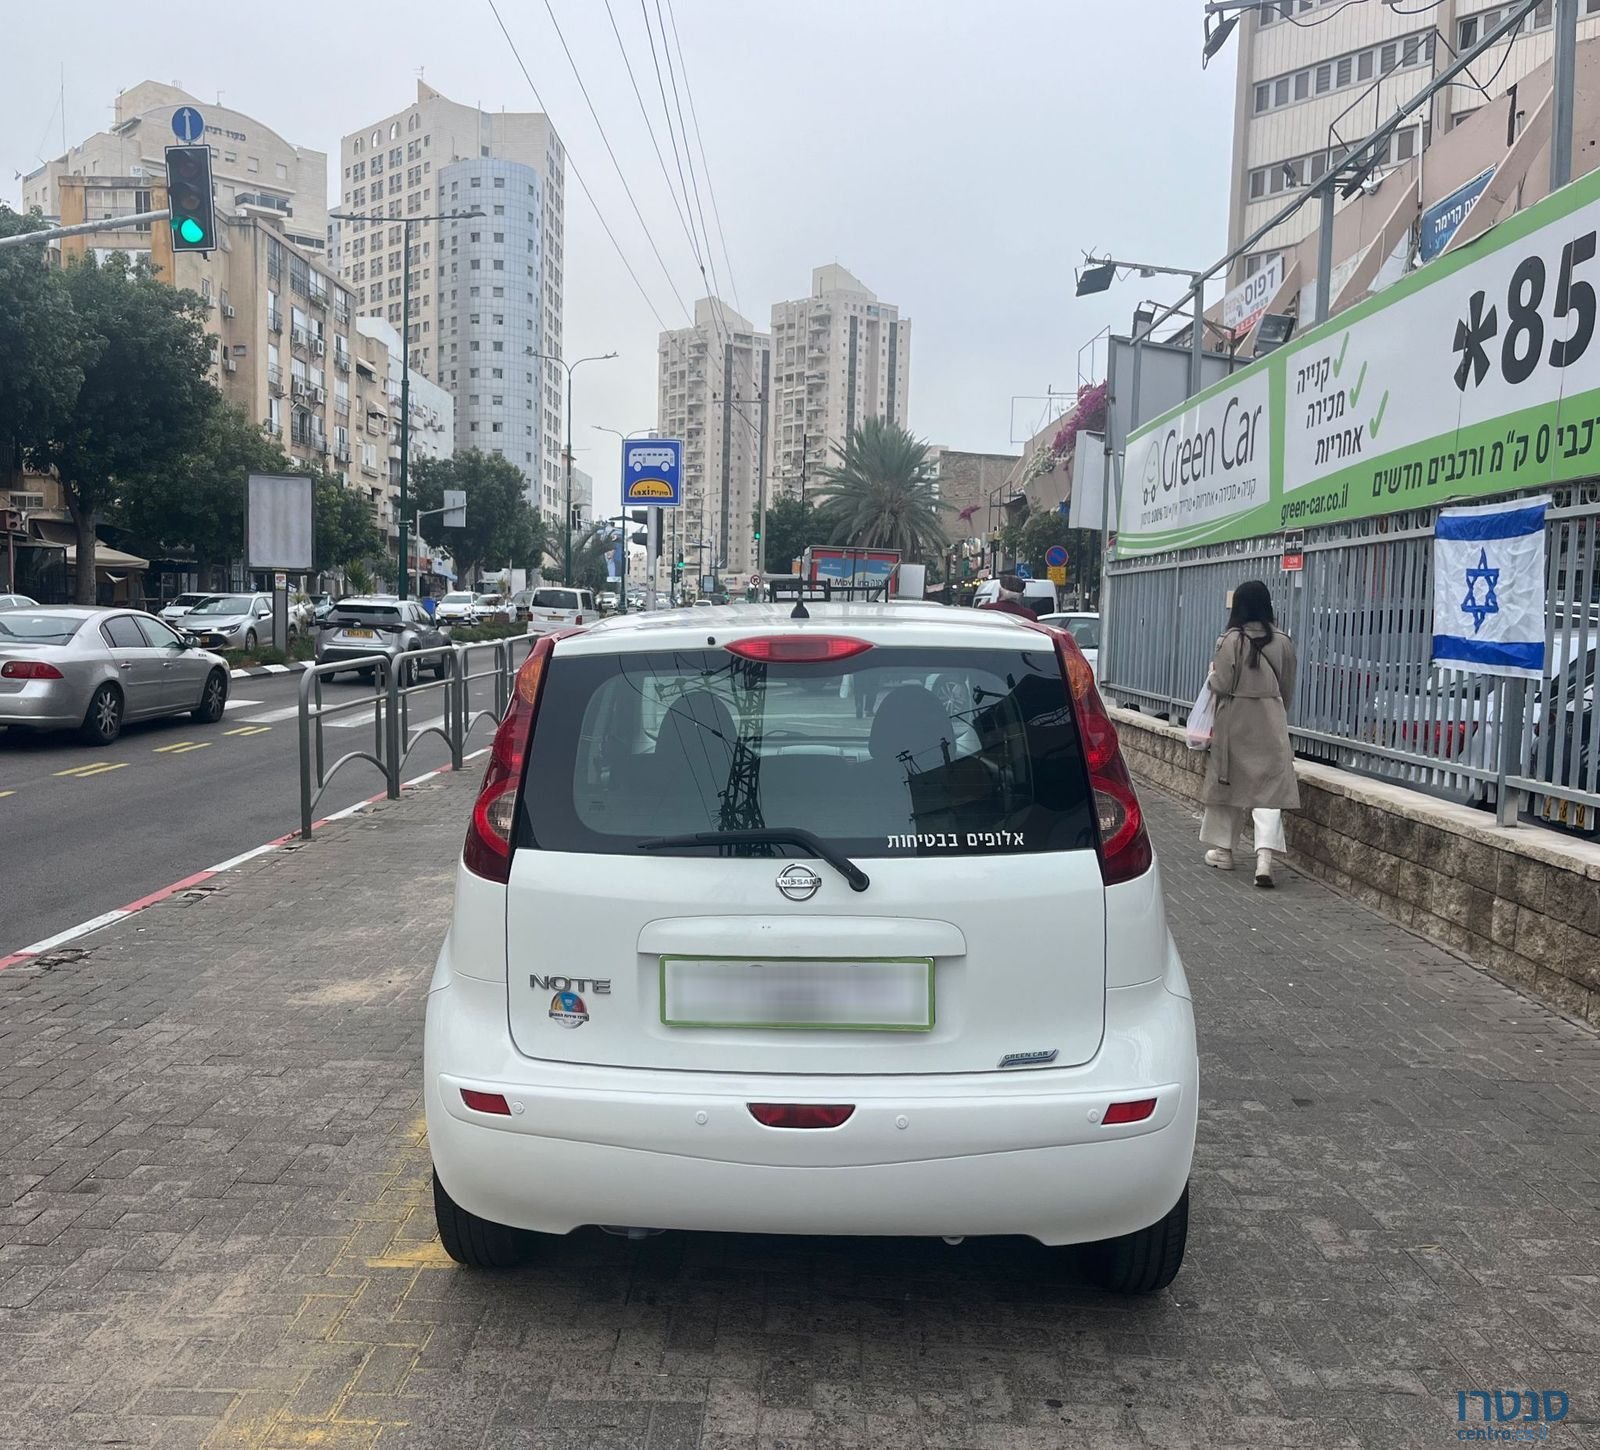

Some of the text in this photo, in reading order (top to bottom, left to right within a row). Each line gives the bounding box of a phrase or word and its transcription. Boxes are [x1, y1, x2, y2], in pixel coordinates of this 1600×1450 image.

[1245, 266, 1275, 306] דפוס
[1297, 356, 1330, 395] קנייה
[1306, 390, 1345, 430] מכירה
[1163, 397, 1262, 492] Green Car
[1314, 425, 1364, 466] אחריות
[1536, 423, 1550, 464] 0
[1557, 416, 1600, 459] כבי
[1372, 462, 1423, 498] חדשים
[1427, 445, 1485, 486] ורכבים
[1281, 482, 1349, 526] green-car.co.il
[887, 830, 1024, 848] אלופים בבטיחות
[529, 973, 612, 995] NOTE
[1004, 1050, 1049, 1060] GREEN CAR
